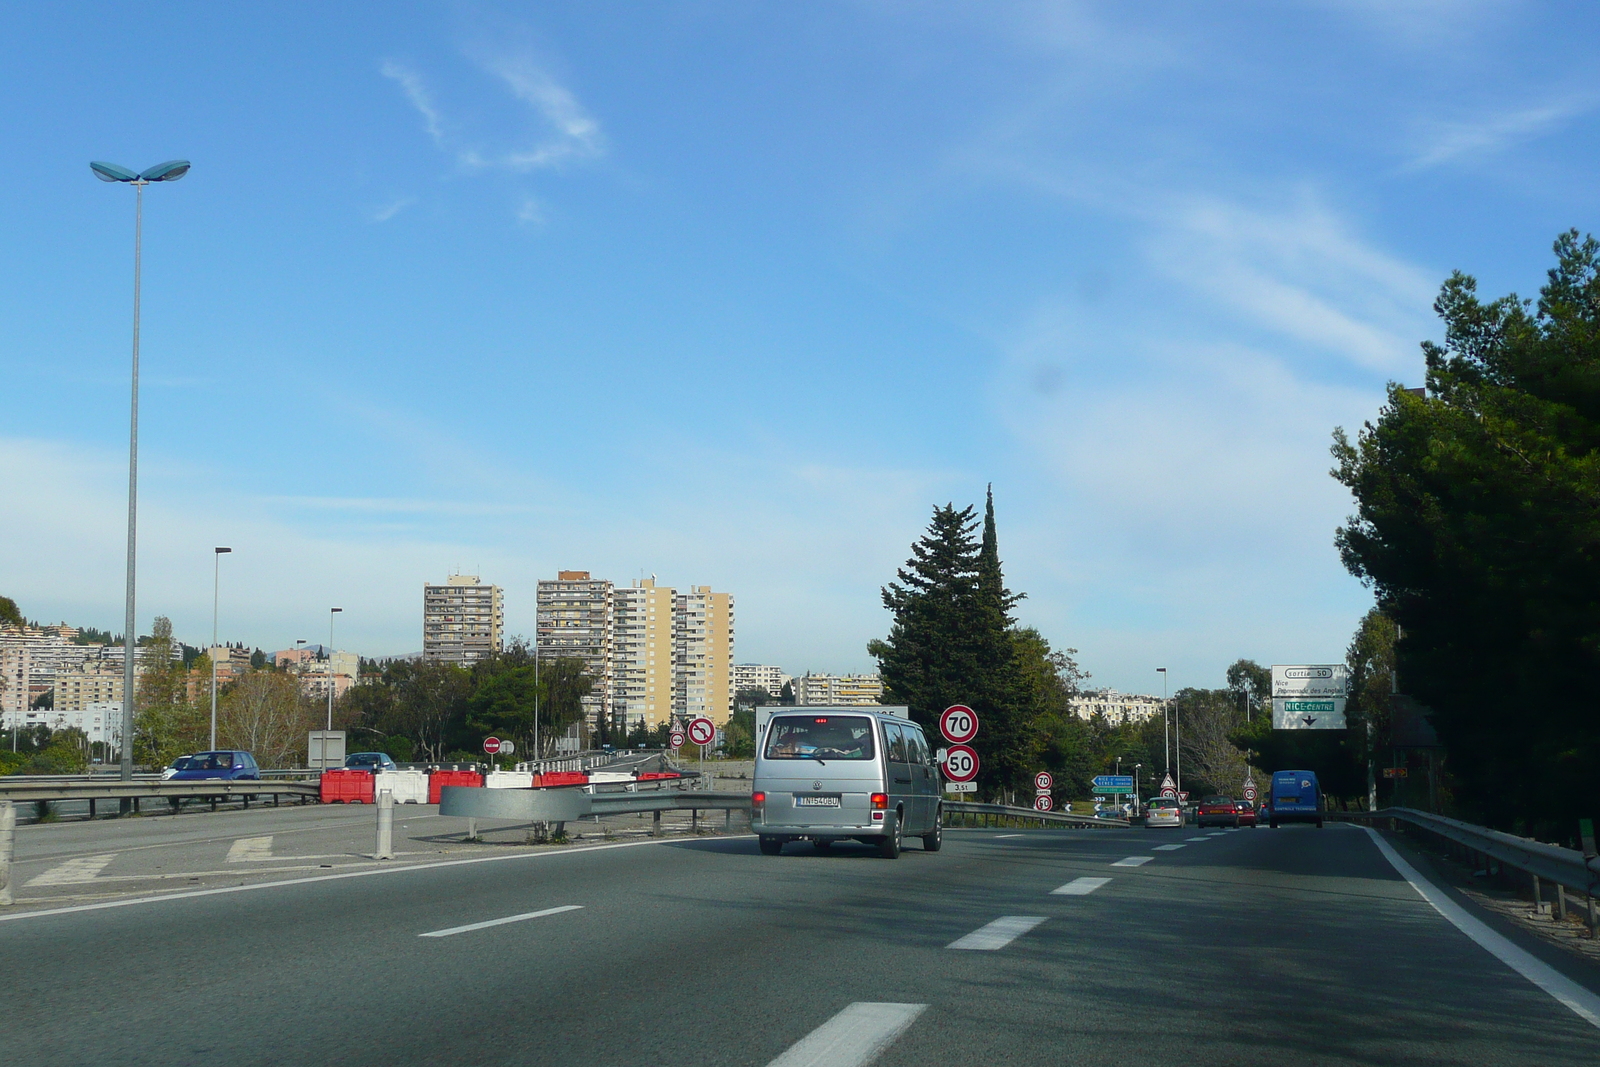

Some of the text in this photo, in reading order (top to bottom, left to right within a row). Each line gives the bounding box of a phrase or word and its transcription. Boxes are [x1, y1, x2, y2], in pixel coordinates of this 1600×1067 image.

[1285, 702, 1334, 711] NICE-CENTRE
[949, 716, 970, 732] 70
[949, 756, 972, 771] 50
[1038, 777, 1049, 785] 70
